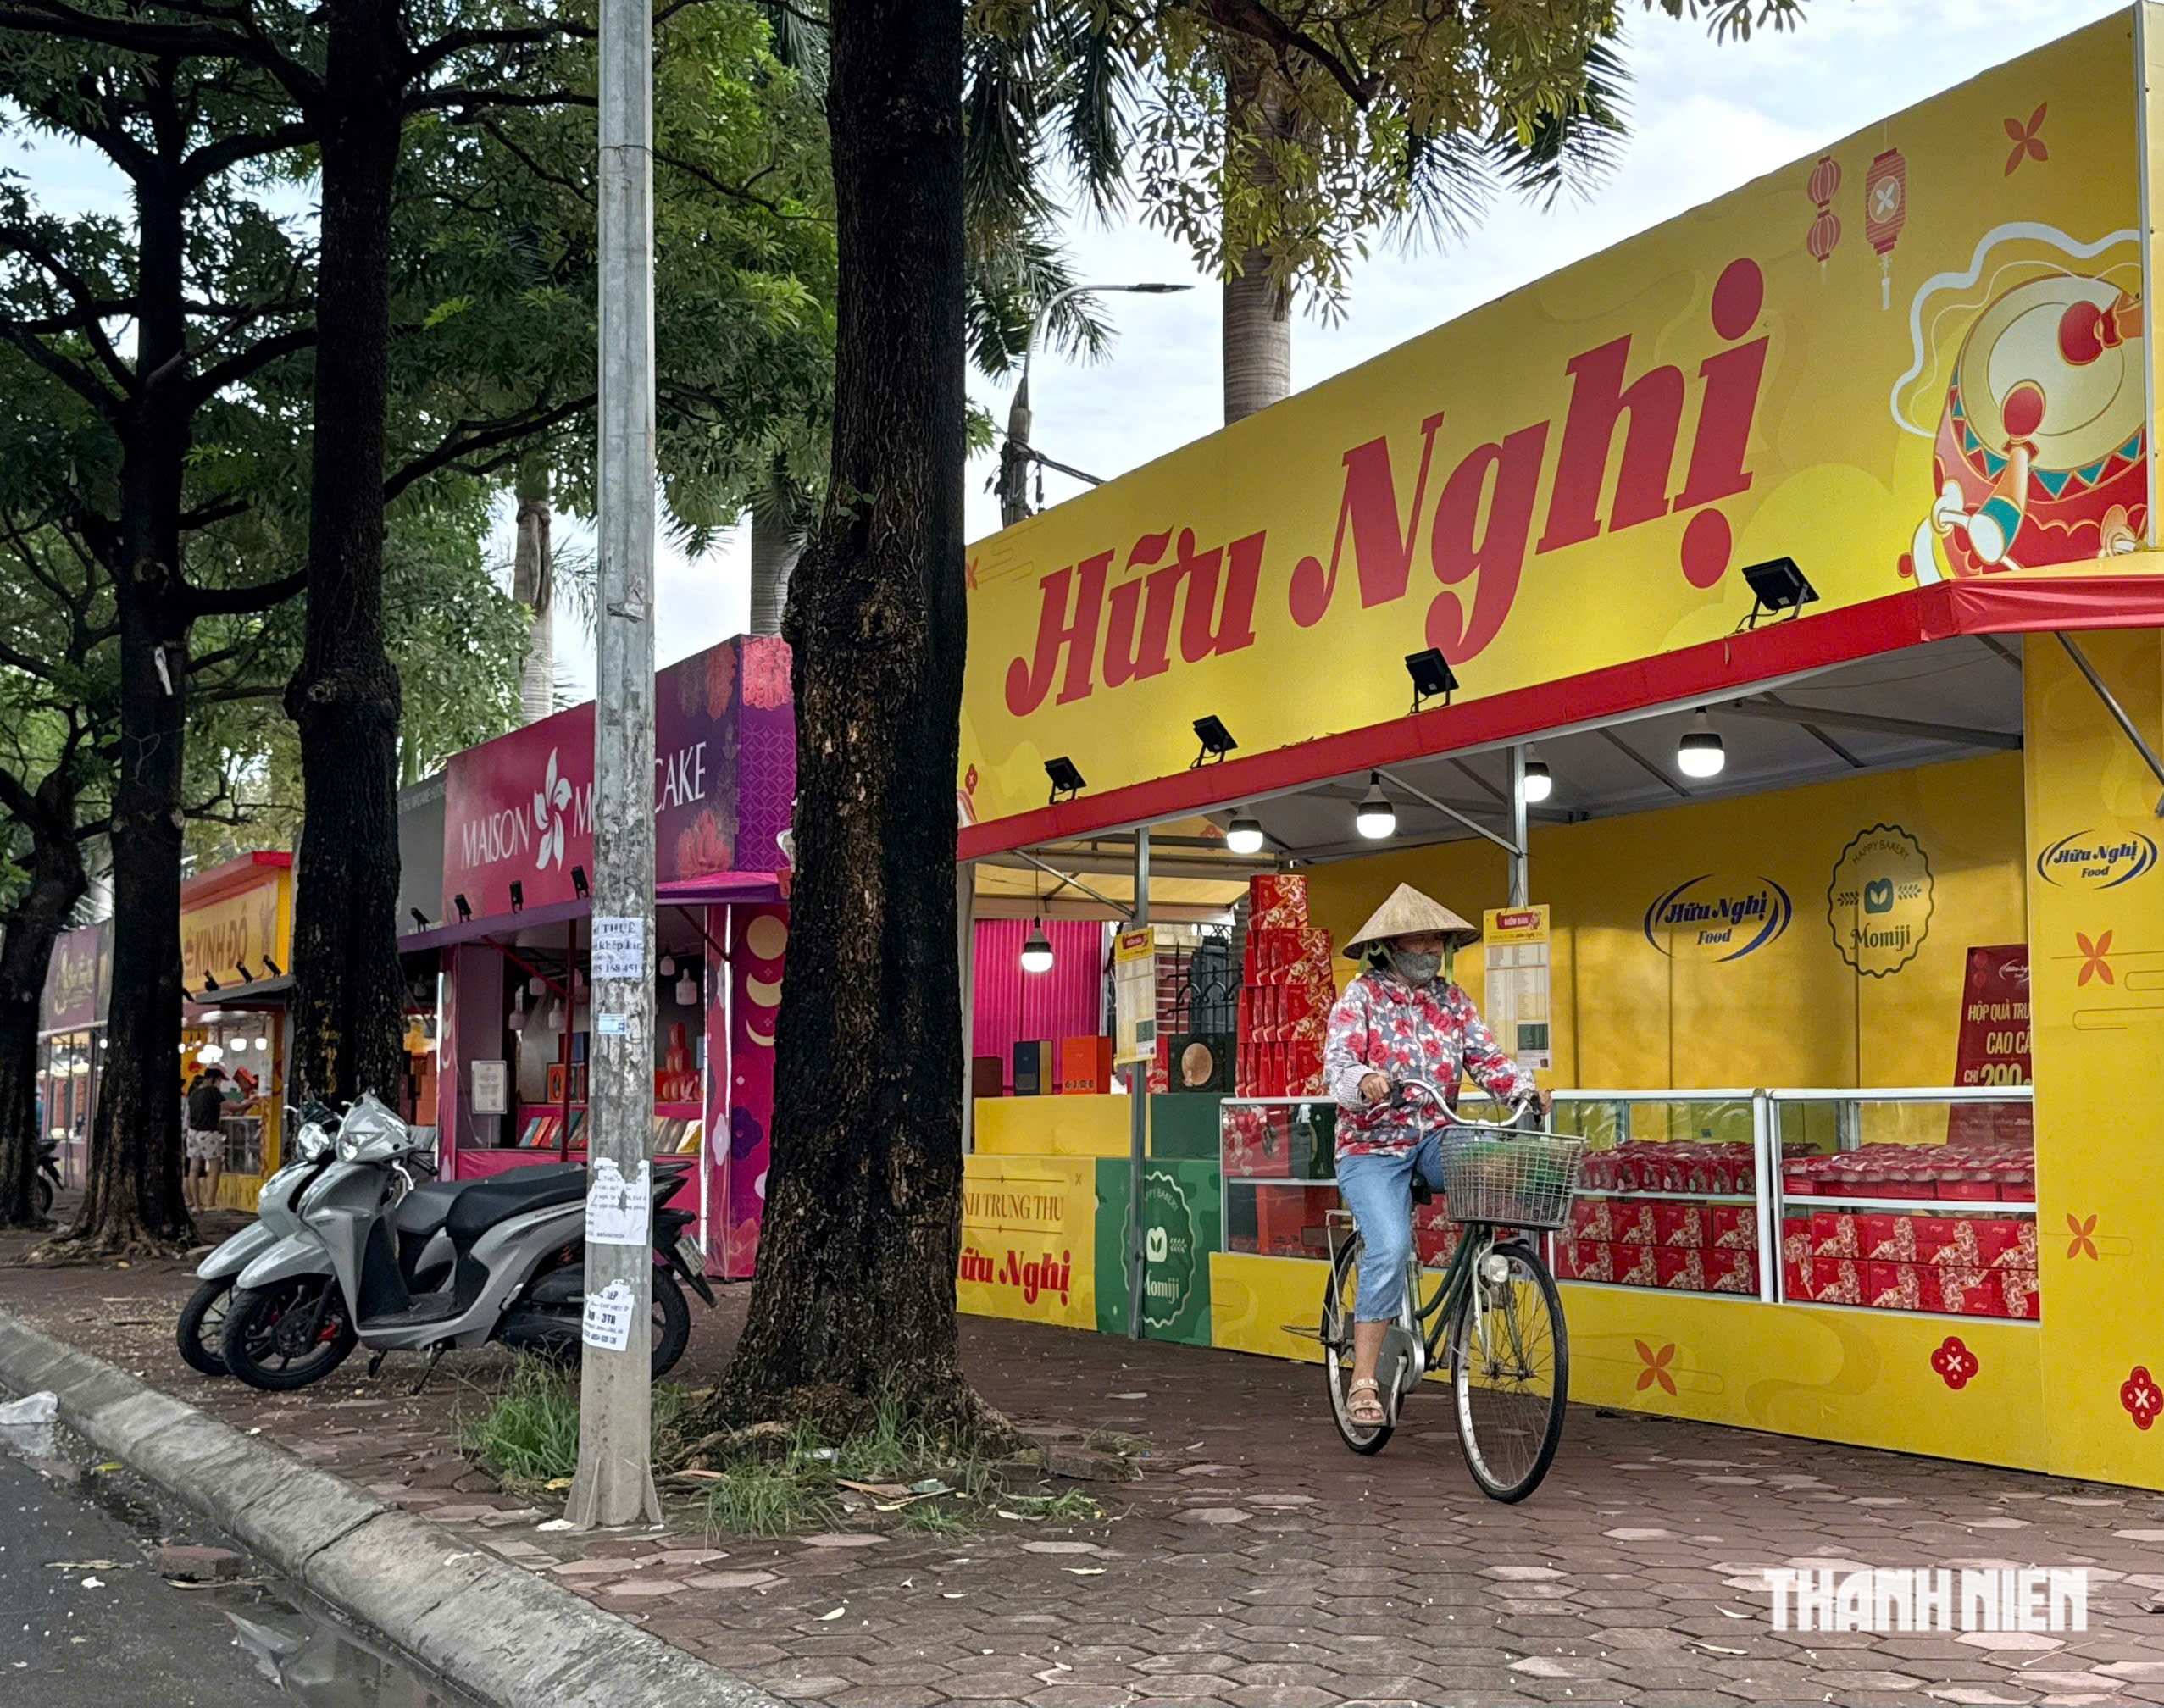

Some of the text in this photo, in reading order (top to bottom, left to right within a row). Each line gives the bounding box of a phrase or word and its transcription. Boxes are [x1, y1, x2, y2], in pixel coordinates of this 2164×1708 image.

[1005, 257, 1771, 718] Hữu Nghị
[461, 802, 531, 870] MAISON
[1852, 840, 1878, 864] HAPPY
[2053, 840, 2139, 864] Hữu Nghị
[2081, 866, 2111, 879] Food
[1664, 890, 1768, 925] Hữu Nghị
[1697, 928, 1733, 946] Food
[1850, 922, 1911, 951] Momiji
[194, 923, 226, 979] KINH
[1967, 1000, 1989, 1024] HỘP
[1986, 1031, 2014, 1055] CAO
[982, 1193, 1032, 1219] TRUNG
[1033, 1195, 1065, 1221] THU
[958, 1246, 1071, 1306] ữu Nghị
